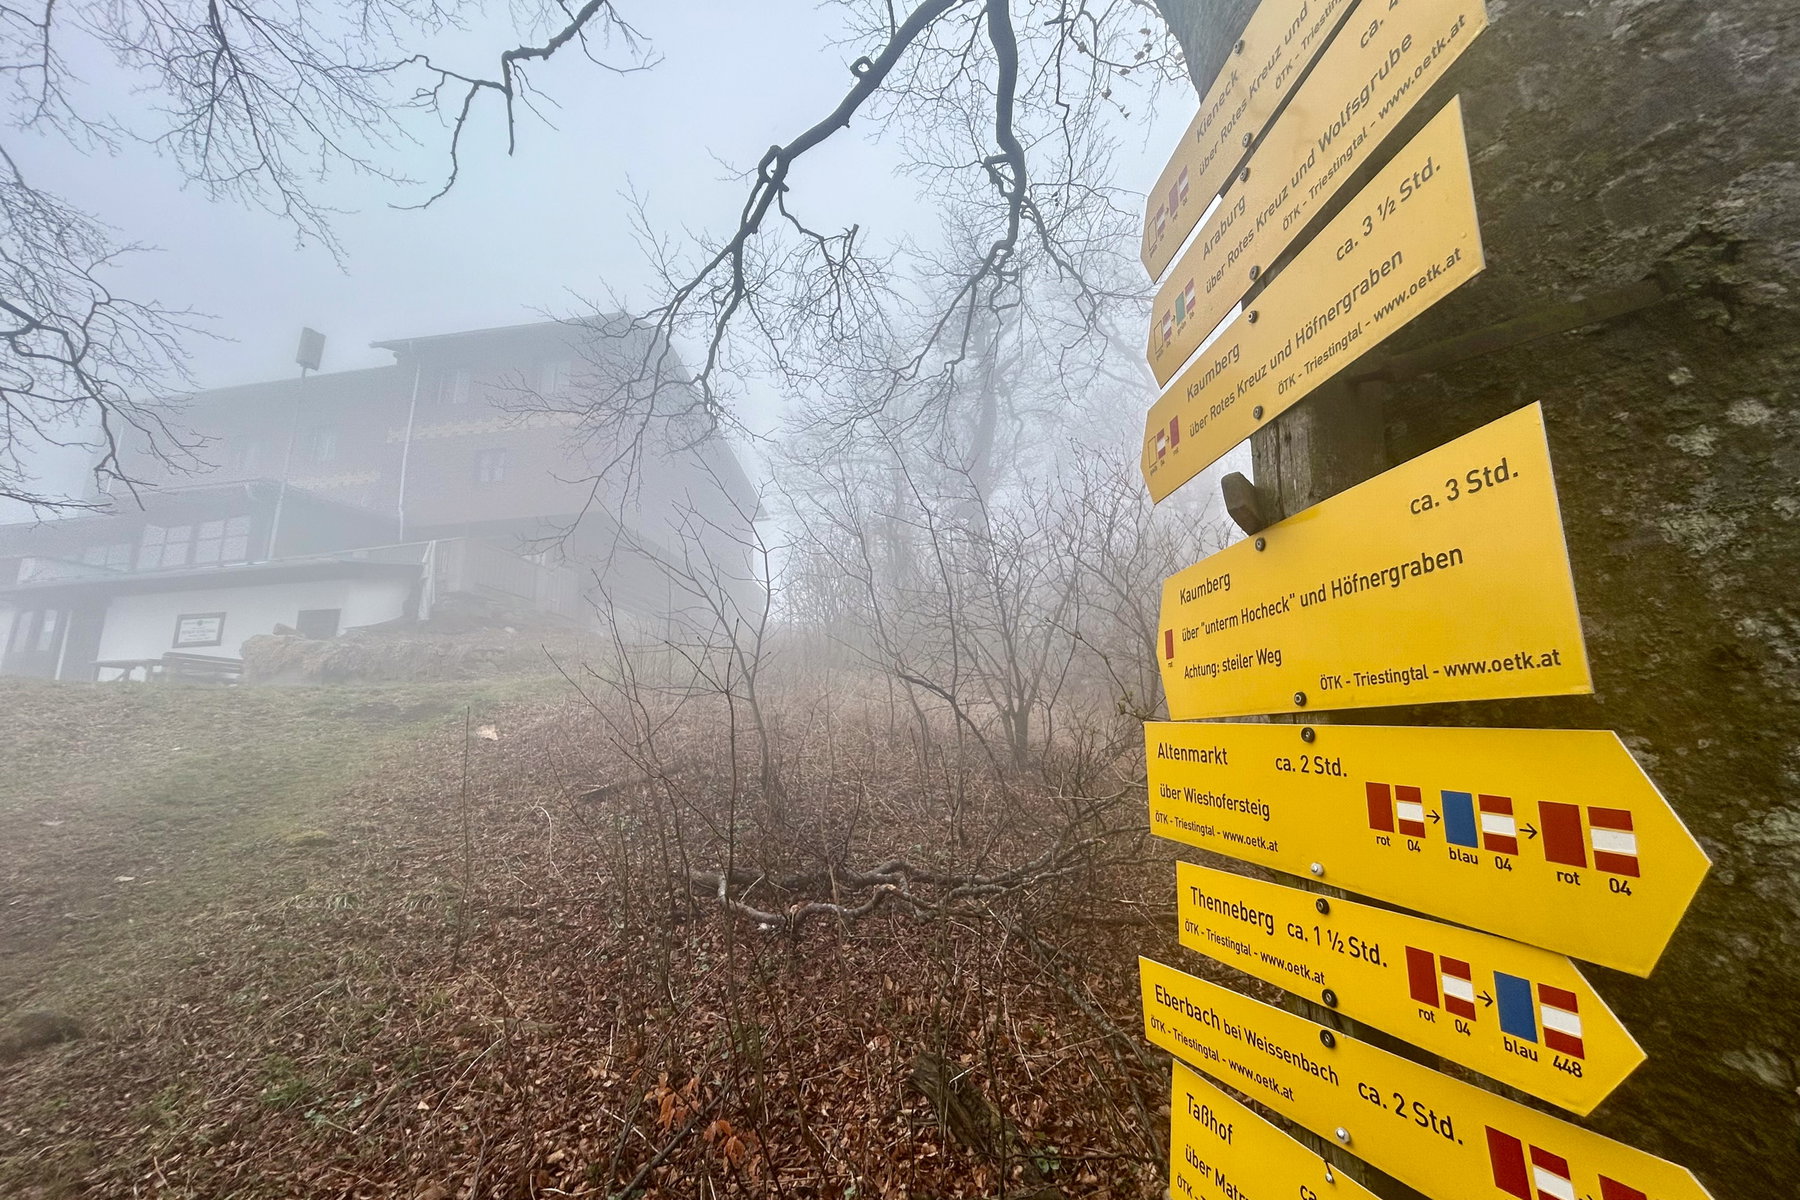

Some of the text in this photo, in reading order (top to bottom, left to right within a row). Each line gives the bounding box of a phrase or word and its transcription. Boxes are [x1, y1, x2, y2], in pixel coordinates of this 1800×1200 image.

[1275, 59, 1293, 90] ÖTK
[1301, 0, 1342, 50] Triestin
[1360, 19, 1384, 49] ca.
[1196, 69, 1239, 143] Kieneck
[1199, 0, 1307, 176] über Rotes Kreuz und
[1282, 204, 1301, 231] ÖTK
[1308, 126, 1368, 200] Triestingtal
[1378, 14, 1466, 120] www.oetk.at
[1206, 34, 1412, 294] über Rotes Kreuz und Wolfsgrube
[1203, 195, 1246, 260] Araburg
[1335, 237, 1359, 261] ca.
[1362, 215, 1373, 237] 3
[1399, 156, 1441, 203] Std.
[1189, 250, 1403, 438] über Rotes Kreuz und Höfnergraben
[1278, 373, 1297, 396] ÖTK
[1304, 326, 1363, 376] Triestingtal
[1373, 248, 1462, 323] www.oetk.at
[1186, 343, 1240, 401] Kaumberg
[1409, 457, 1519, 515] ca. 3 Std.
[1179, 573, 1231, 605] Kaumberg
[1181, 626, 1200, 642] über
[1300, 583, 1327, 608] und
[1331, 547, 1464, 600] Höfnergraben
[1184, 647, 1282, 679] Achtung: steiler Weg
[1320, 674, 1343, 691] ÖTK
[1353, 664, 1429, 688] Triestingtal
[1443, 649, 1561, 678] www.oetk.at
[1157, 742, 1348, 778] Altenmarkt ca. 2 Std.
[1155, 810, 1168, 825] ÖTK
[1174, 816, 1215, 837] Triestingtal
[1222, 830, 1279, 853] www.oetk.at
[1159, 783, 1270, 821] über Wieshofersteig
[1376, 835, 1632, 896] rot 04 blau 04 rot 04
[1184, 918, 1199, 936] ÖTK
[1206, 928, 1251, 956] Triestingtal
[1260, 951, 1325, 985] www.oetk.at
[1190, 886, 1275, 936] Thenneberg
[1287, 921, 1308, 942] ca.
[1313, 925, 1321, 946] 1
[1348, 935, 1388, 968] Std.
[1151, 1015, 1166, 1034] ÖTK
[1172, 1027, 1220, 1063] Triestingtal
[1228, 1059, 1294, 1102] www.oetk.at
[1154, 984, 1463, 1145] Eberbach bei Weissenbach ca. 2 Std.
[1418, 1008, 1583, 1078] rot 04 blau 448
[1186, 1092, 1233, 1145] Taßhof
[1177, 1172, 1193, 1199] ÖTK
[1185, 1144, 1249, 1200] über Matr
